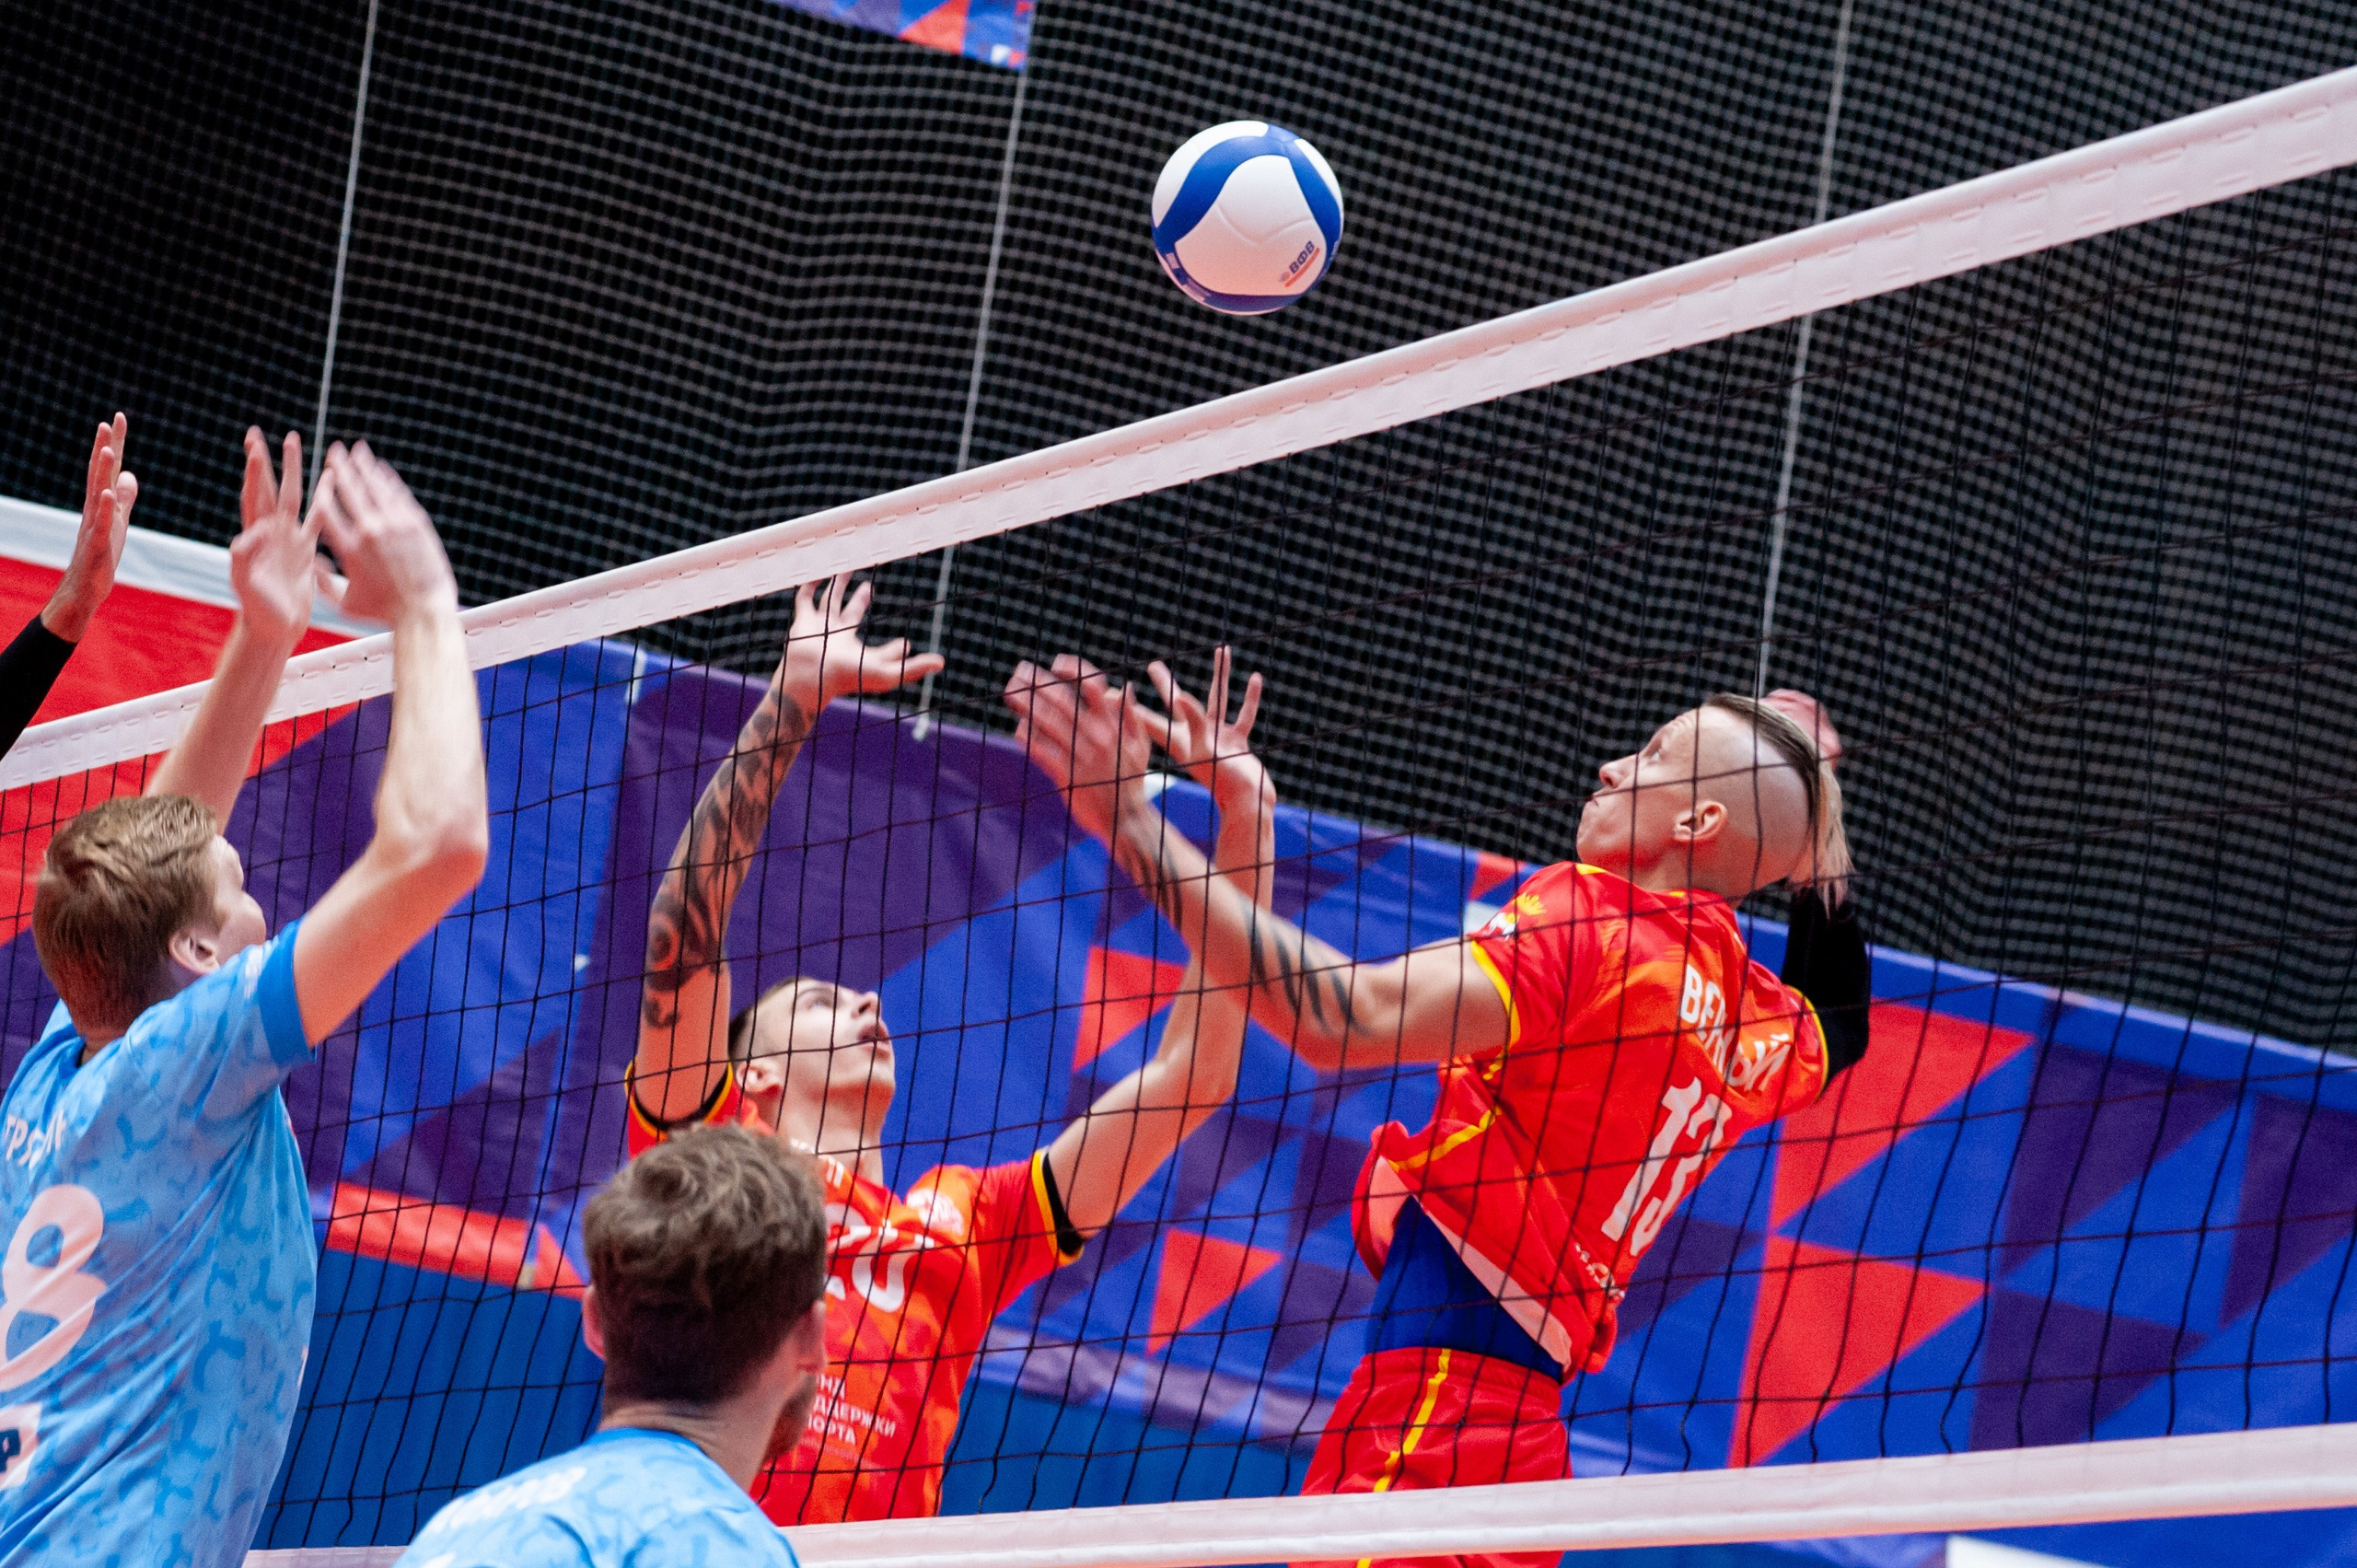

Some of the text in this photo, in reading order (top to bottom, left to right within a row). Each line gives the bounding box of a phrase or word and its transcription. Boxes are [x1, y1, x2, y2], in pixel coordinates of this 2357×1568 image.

[1289, 240, 1315, 274] ВФВ
[1600, 1076, 1732, 1257] 13
[0, 1184, 108, 1392] 8
